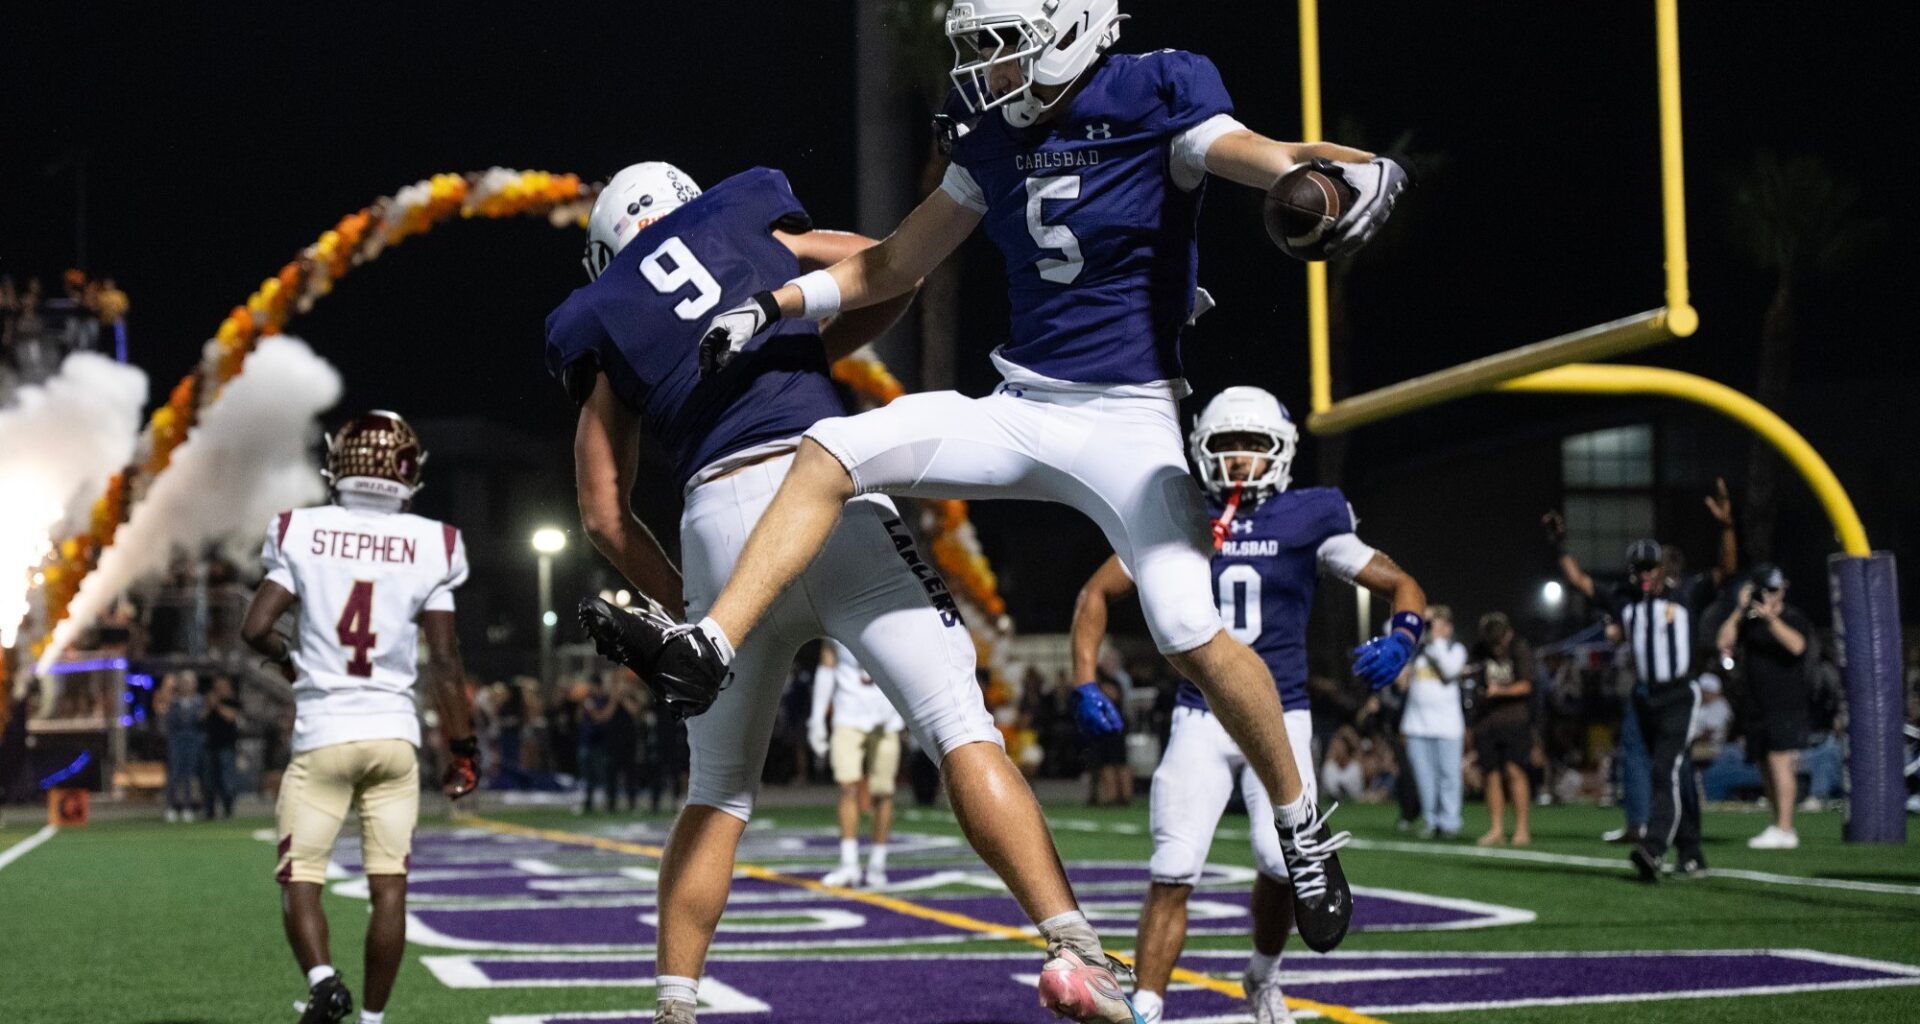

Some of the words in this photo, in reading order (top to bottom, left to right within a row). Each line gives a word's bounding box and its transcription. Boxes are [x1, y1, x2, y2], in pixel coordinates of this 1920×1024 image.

[1015, 150, 1100, 170] CARLSBAD
[1025, 175, 1084, 284] 5
[639, 236, 722, 320] 9
[311, 528, 417, 564] STEPHEN
[883, 518, 966, 628] LANCERS
[1221, 539, 1279, 556] RLSBAD
[336, 578, 377, 678] 4
[1218, 564, 1262, 645] 0
